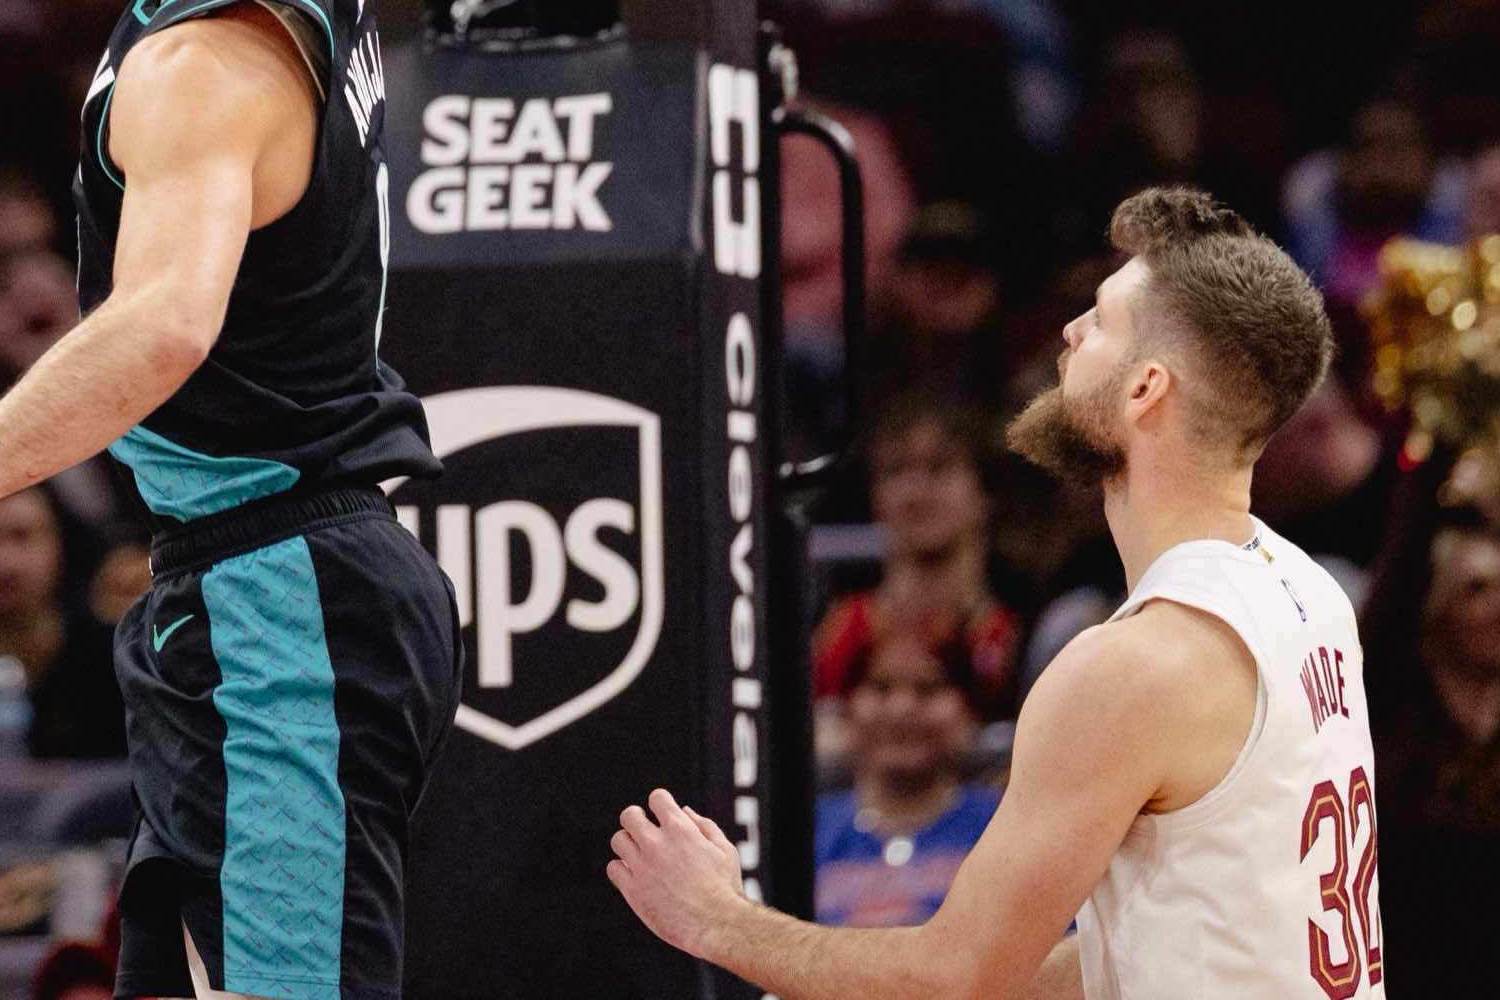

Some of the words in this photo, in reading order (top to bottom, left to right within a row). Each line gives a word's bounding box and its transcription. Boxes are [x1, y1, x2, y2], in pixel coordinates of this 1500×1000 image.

[420, 93, 613, 166] SEAT
[405, 162, 613, 234] GEEK
[1299, 646, 1350, 734] WADE
[1299, 766, 1382, 1000] 32
